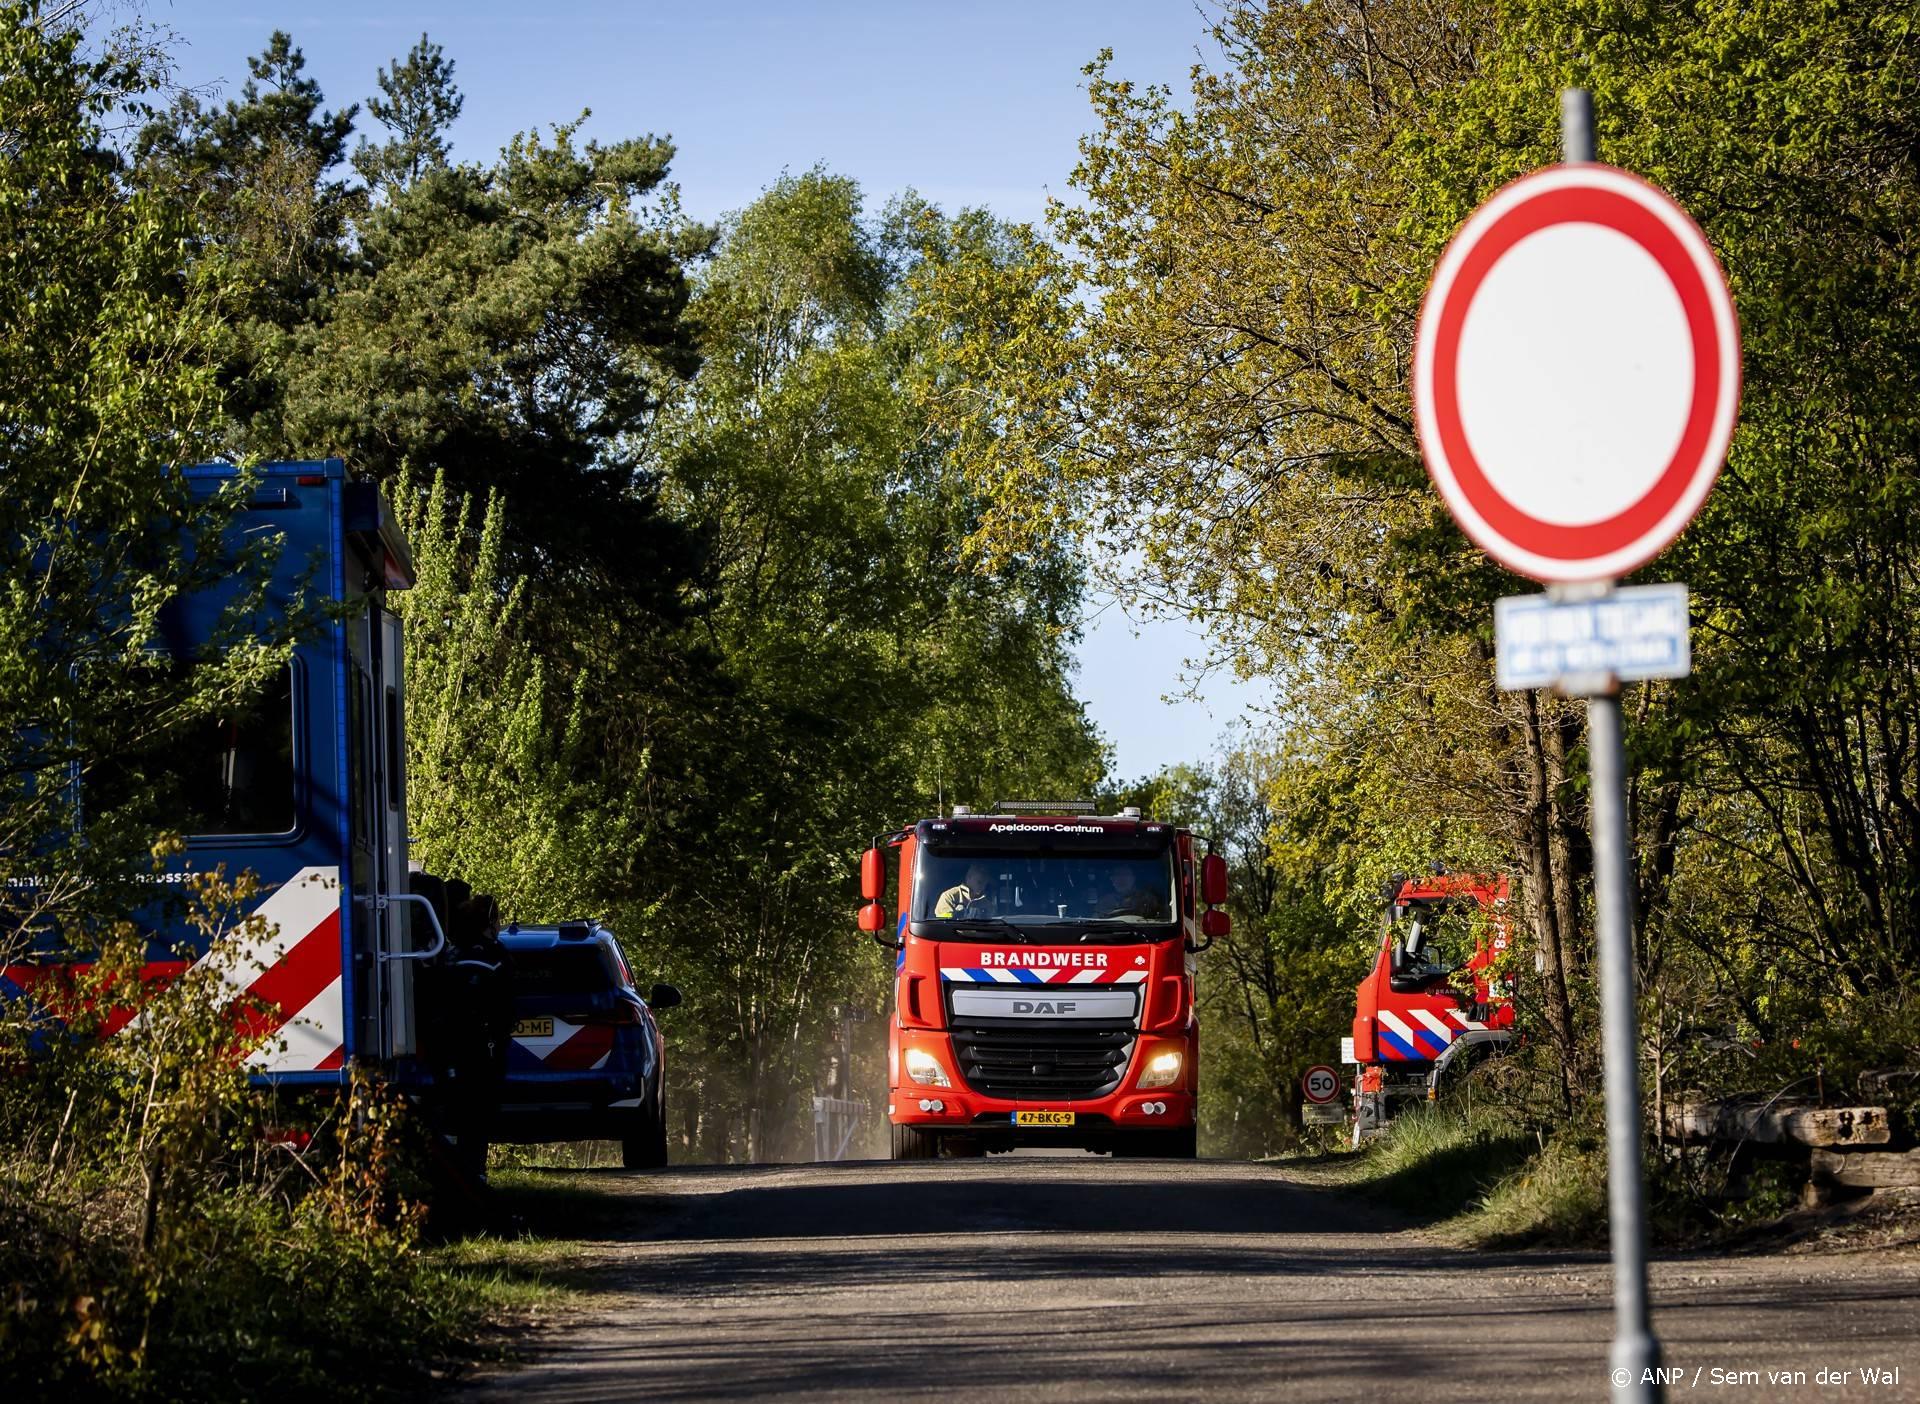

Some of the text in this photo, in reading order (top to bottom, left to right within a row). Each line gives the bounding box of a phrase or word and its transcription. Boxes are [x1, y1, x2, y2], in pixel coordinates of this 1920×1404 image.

[989, 823, 1104, 833] Apeldoorn-Centrum
[980, 952, 1108, 967] BRANDWEER
[1012, 1001, 1076, 1014] DAF
[514, 1021, 552, 1034] 0-MF
[1310, 1077, 1334, 1091] 50
[1020, 1113, 1072, 1123] 47-BKG-9
